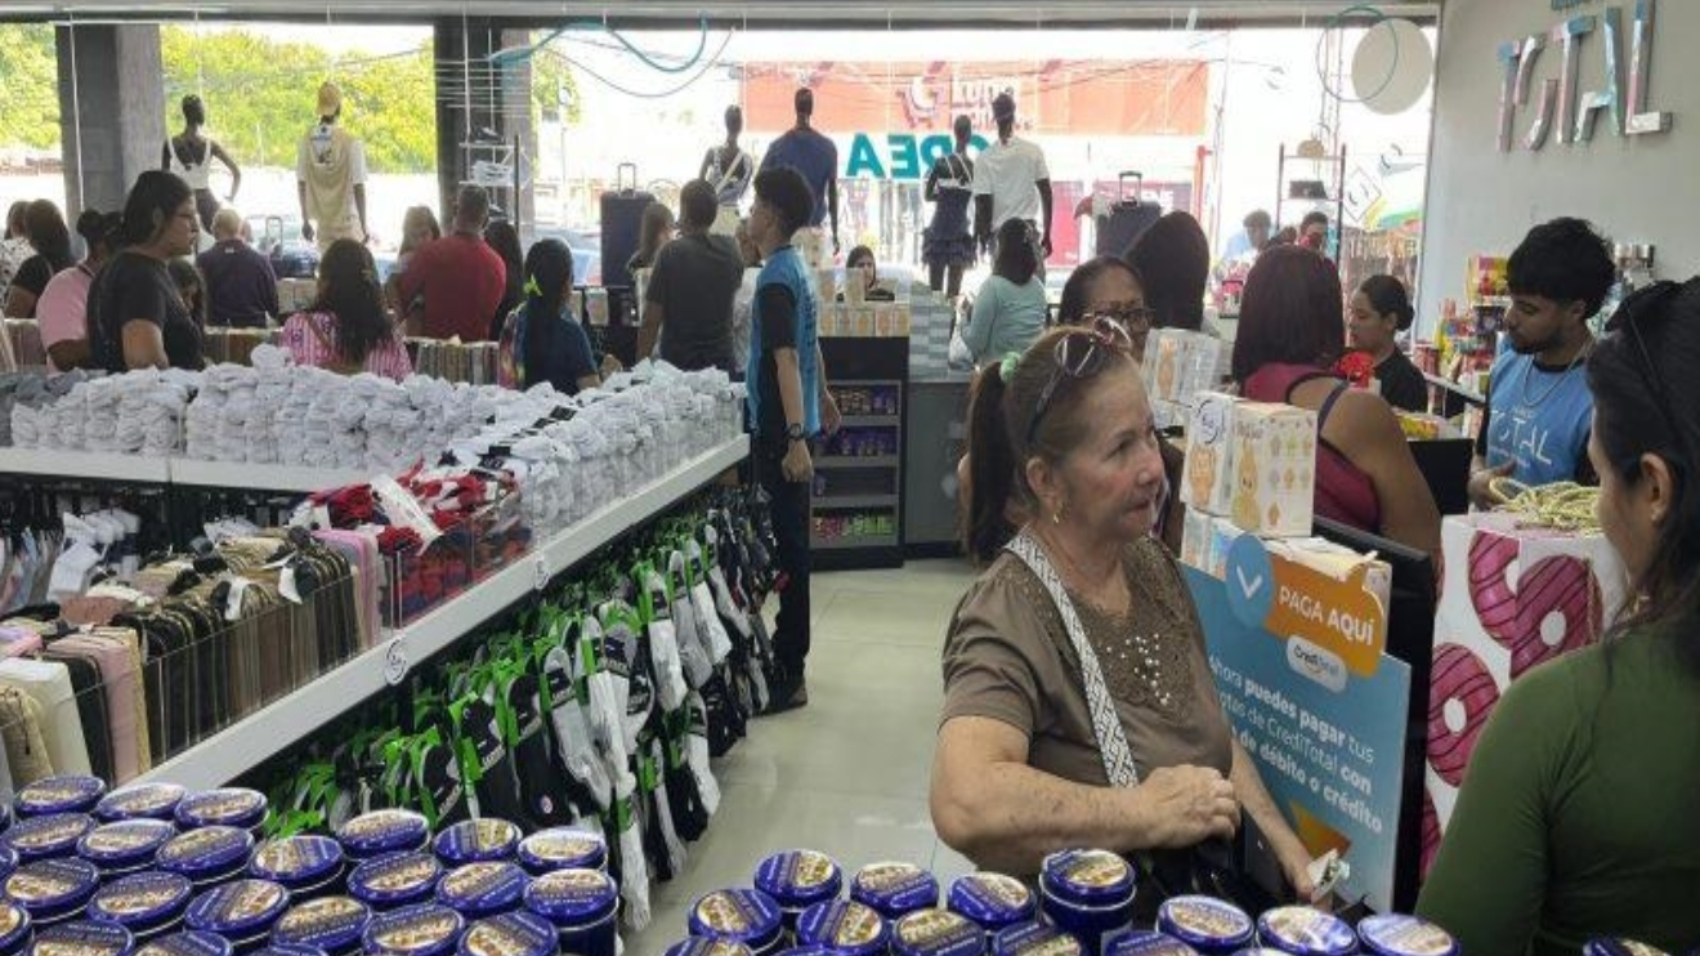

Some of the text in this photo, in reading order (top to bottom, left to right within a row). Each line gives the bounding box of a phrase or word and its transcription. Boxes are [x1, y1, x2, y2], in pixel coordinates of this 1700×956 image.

[1278, 585, 1375, 646] PAGA AQUÍ
[1220, 692, 1246, 718] otas
[1247, 707, 1265, 730] de
[1267, 718, 1338, 775] CrediTotal
[1340, 765, 1372, 796] con
[1244, 677, 1297, 720] puedes
[1299, 709, 1346, 748] pagar
[1349, 737, 1375, 766] tus
[1239, 729, 1383, 834] de débito o crédito
